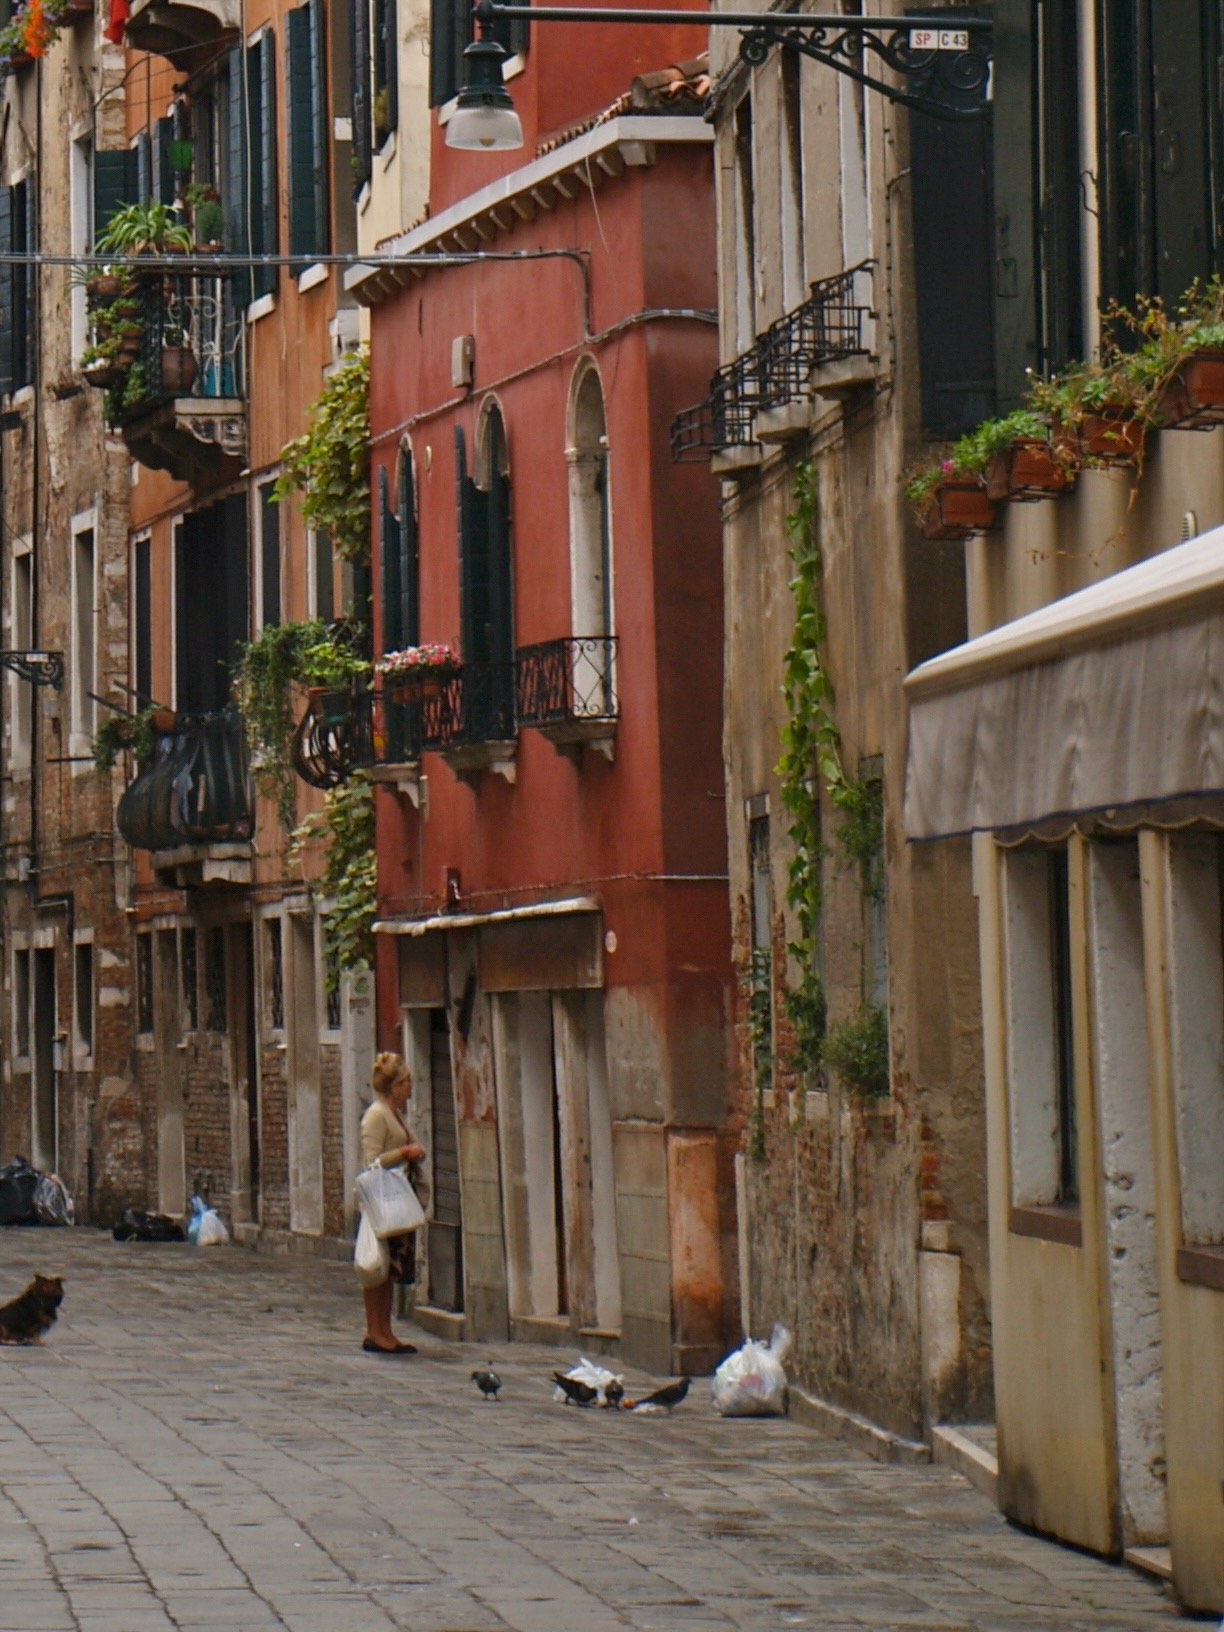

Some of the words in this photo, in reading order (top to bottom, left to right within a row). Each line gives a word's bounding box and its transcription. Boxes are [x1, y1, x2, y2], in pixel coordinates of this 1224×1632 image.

[915, 32, 931, 46] SP
[941, 33, 949, 46] C
[953, 33, 967, 47] 43
